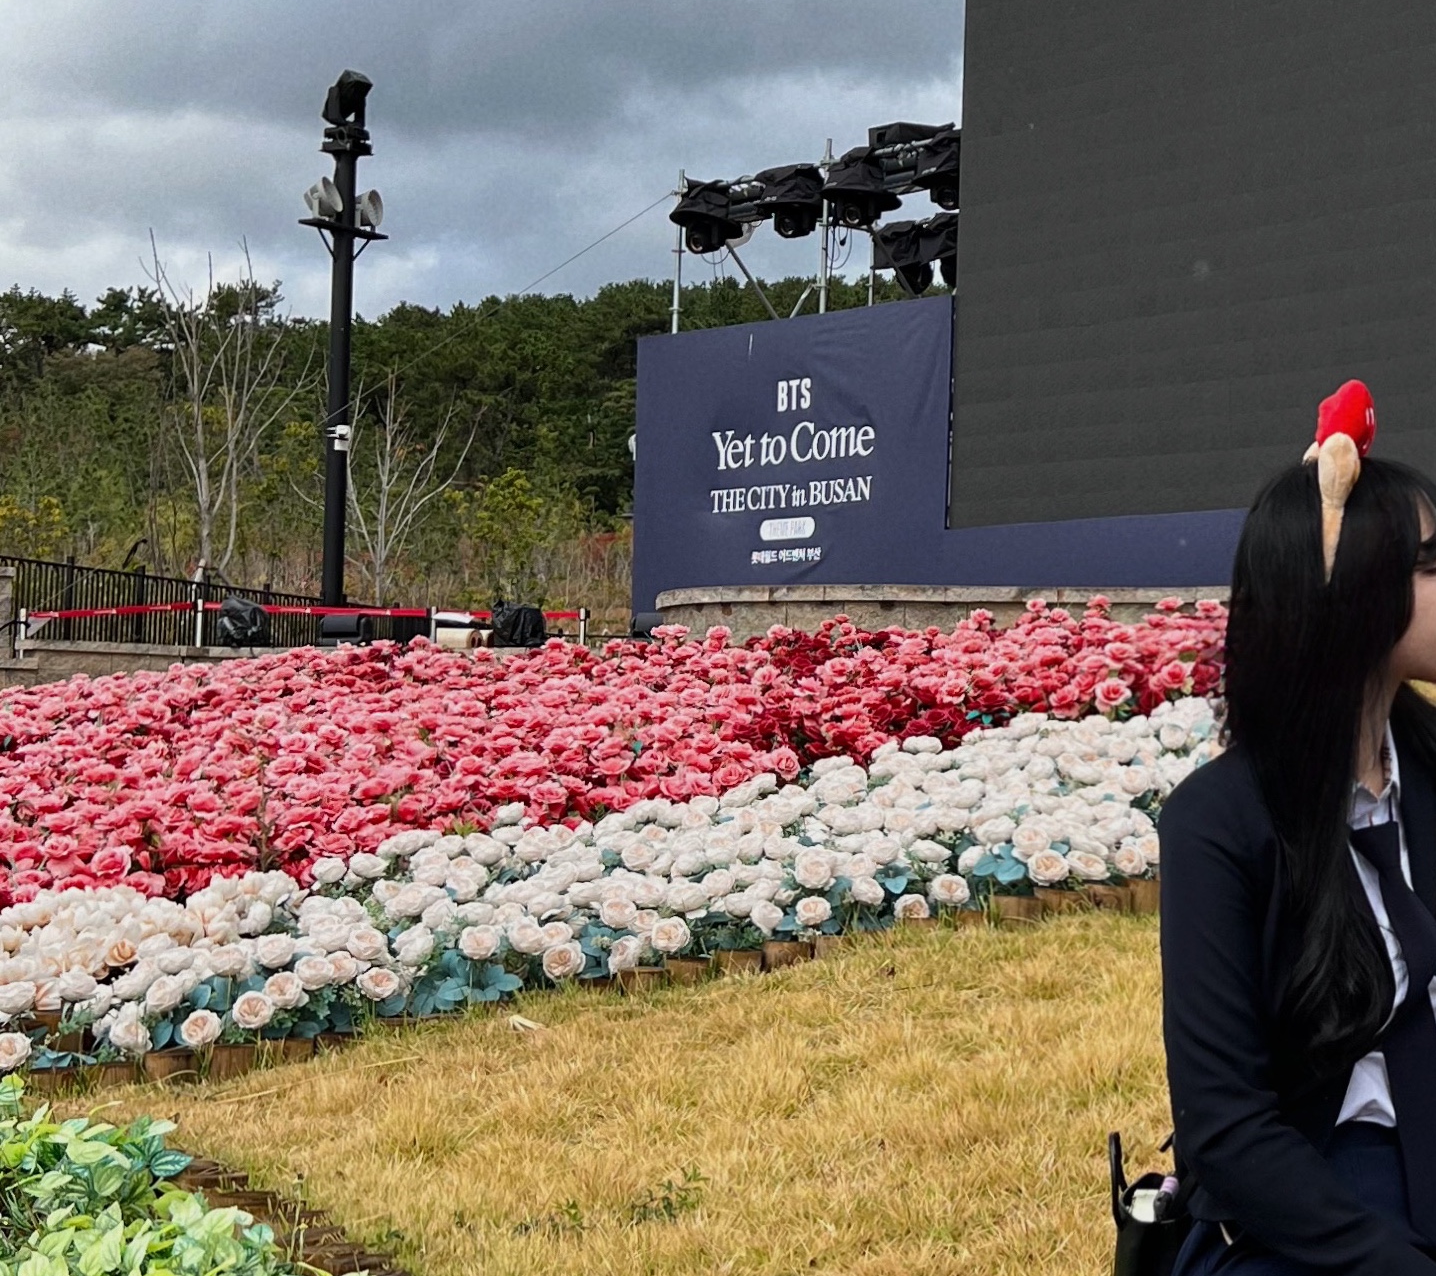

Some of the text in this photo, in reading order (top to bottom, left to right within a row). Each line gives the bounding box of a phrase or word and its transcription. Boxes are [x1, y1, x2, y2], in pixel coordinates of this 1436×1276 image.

[776, 377, 812, 413] BTS
[711, 420, 876, 471] Yet to Come
[710, 475, 873, 514] THE CITY in BUSAN
